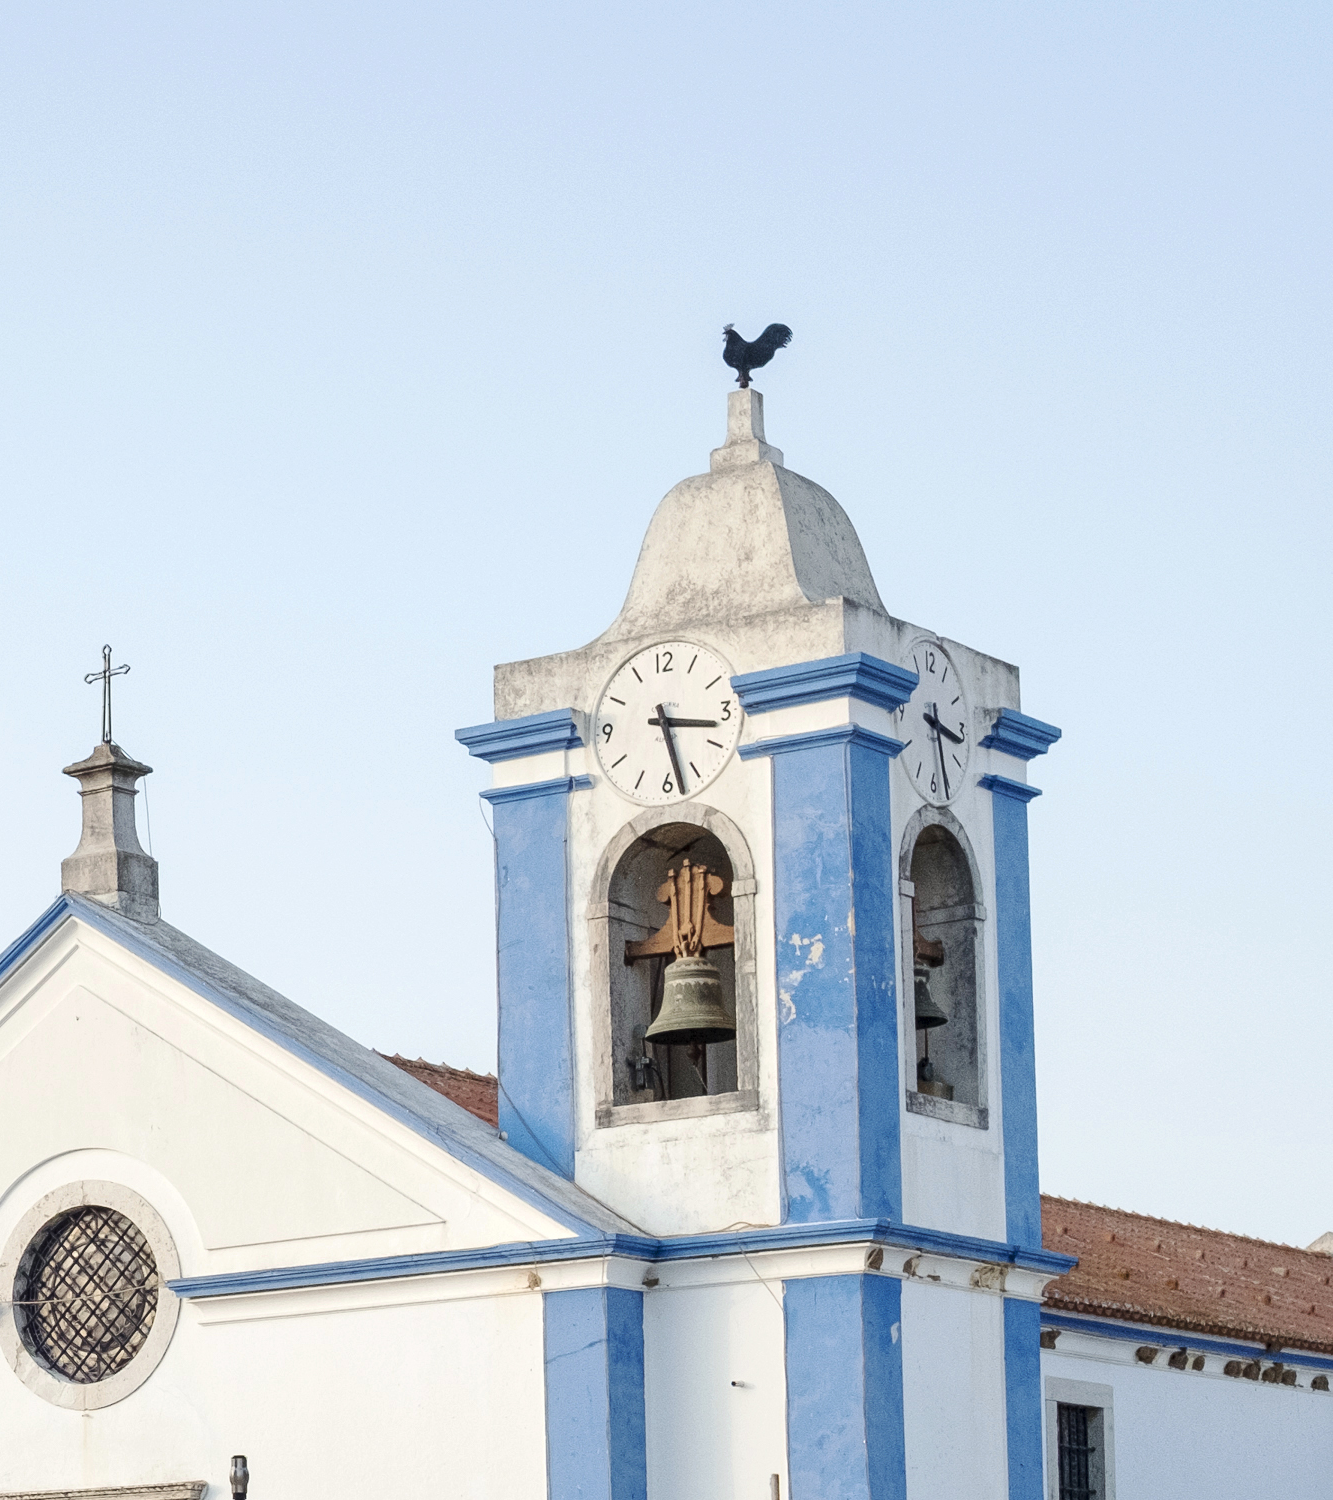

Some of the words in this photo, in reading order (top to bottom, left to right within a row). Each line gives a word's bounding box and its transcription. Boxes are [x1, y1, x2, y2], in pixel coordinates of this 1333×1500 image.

[656, 651, 673, 674] 12
[925, 650, 935, 674] 12
[720, 700, 731, 721] 3
[602, 723, 613, 744] 9
[662, 772, 673, 793] 6
[930, 772, 937, 793] 6
